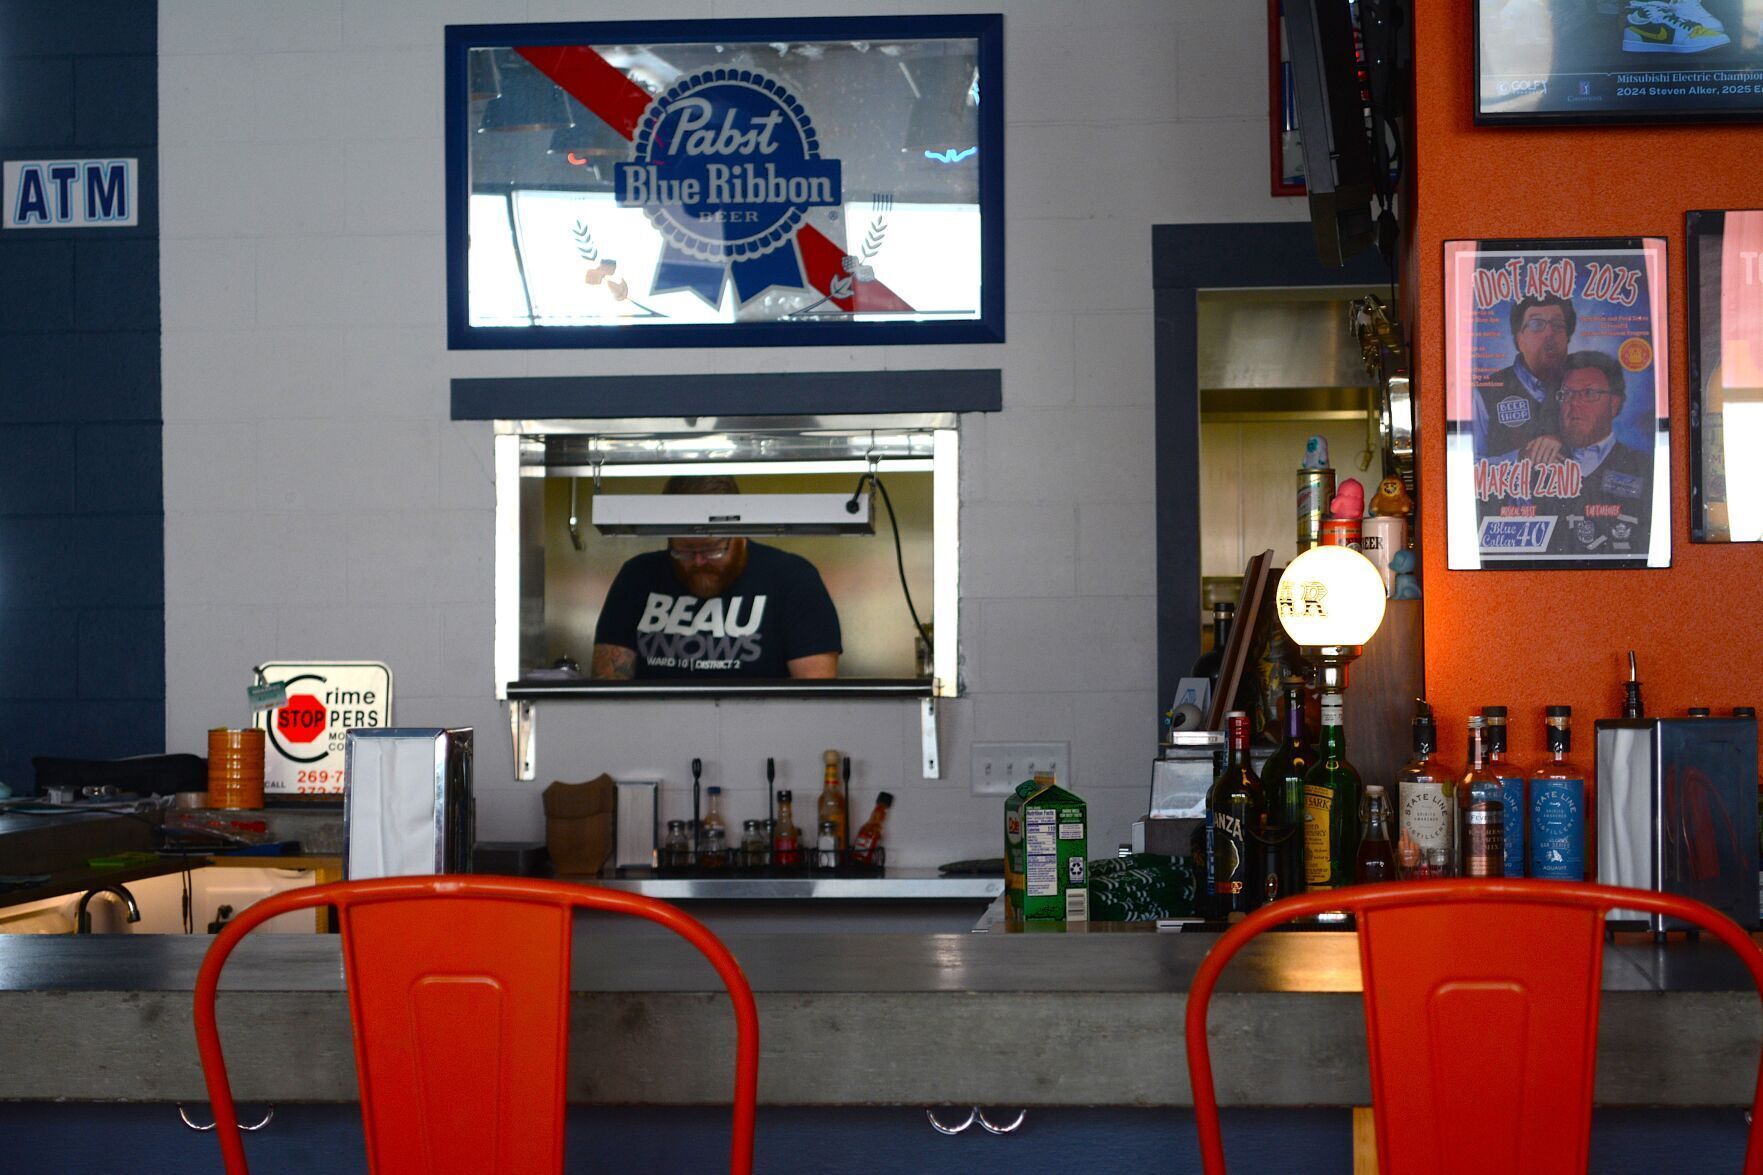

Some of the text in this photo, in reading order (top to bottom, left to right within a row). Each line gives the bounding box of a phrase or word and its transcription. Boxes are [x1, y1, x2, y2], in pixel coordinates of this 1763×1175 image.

[1617, 73, 1670, 83] Mitsubishi
[1672, 72, 1711, 82] Electric
[1616, 84, 1763, 96] 2024 Steven Alker, 2025 E
[666, 97, 783, 156] Pabst
[15, 163, 128, 222] ATM
[622, 163, 834, 206] Blue Ribbon
[700, 211, 759, 223] BEER
[1581, 262, 1642, 307] 2025
[1499, 400, 1527, 412] BEER
[1500, 411, 1529, 422] SHOP
[1474, 458, 1531, 502] MARCH
[1533, 459, 1582, 499] 22ND
[1482, 534, 1516, 548] Collar
[1490, 521, 1546, 548] Blue 40
[637, 592, 767, 638] BEAU
[637, 632, 763, 662] KNOWS
[647, 656, 741, 670] WARD 10 DISTRICT 2
[1405, 793, 1448, 816] STATE LINE
[1535, 791, 1577, 813] STATE LINE
[1406, 821, 1446, 840] DISTILLERY
